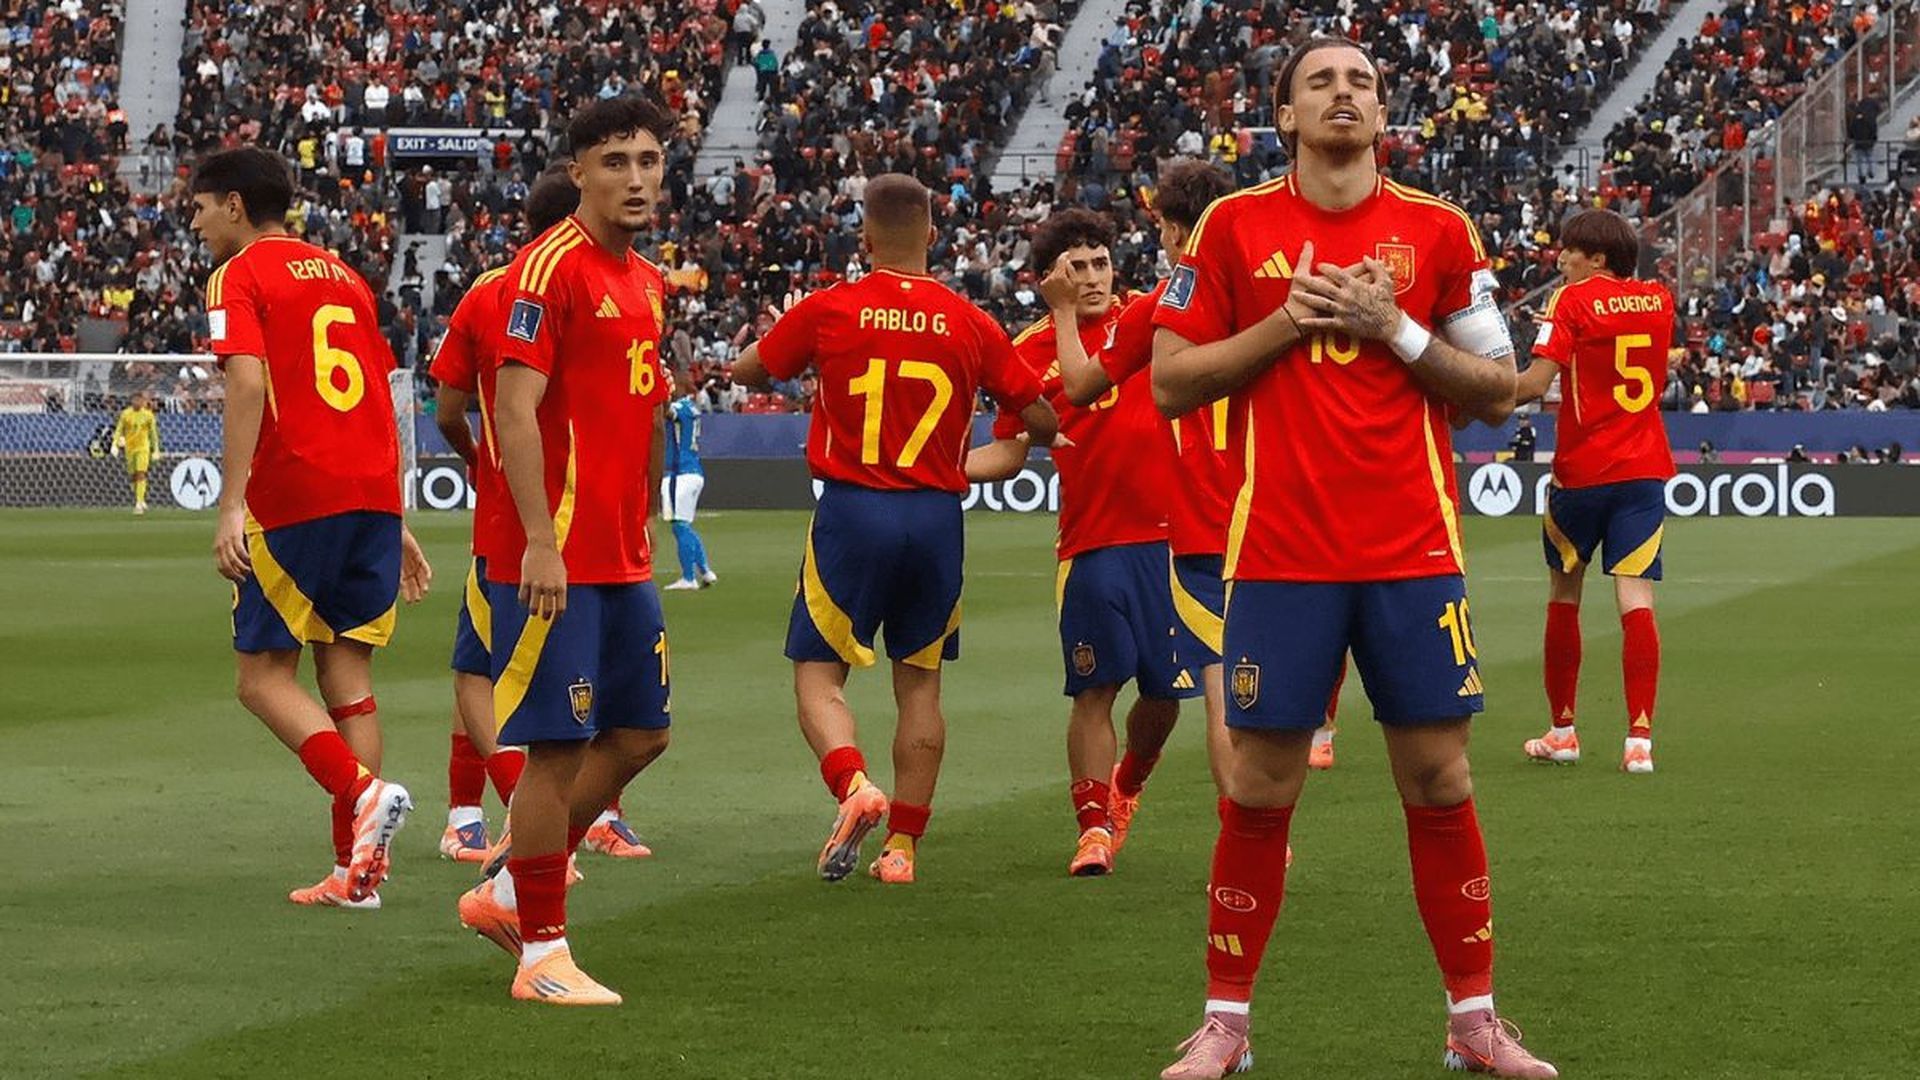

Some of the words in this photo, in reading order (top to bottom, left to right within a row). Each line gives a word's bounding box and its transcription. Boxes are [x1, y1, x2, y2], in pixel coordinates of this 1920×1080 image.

[397, 137, 426, 150] EXIT
[437, 137, 478, 151] SALID
[285, 257, 330, 280] IZAN
[331, 263, 355, 285] M.
[859, 307, 927, 333] PABLO
[932, 313, 951, 337] G.
[312, 304, 365, 413] 6
[626, 338, 655, 396] 16
[1613, 333, 1655, 413] 5
[848, 357, 953, 468] 17
[1535, 464, 1836, 516] orola
